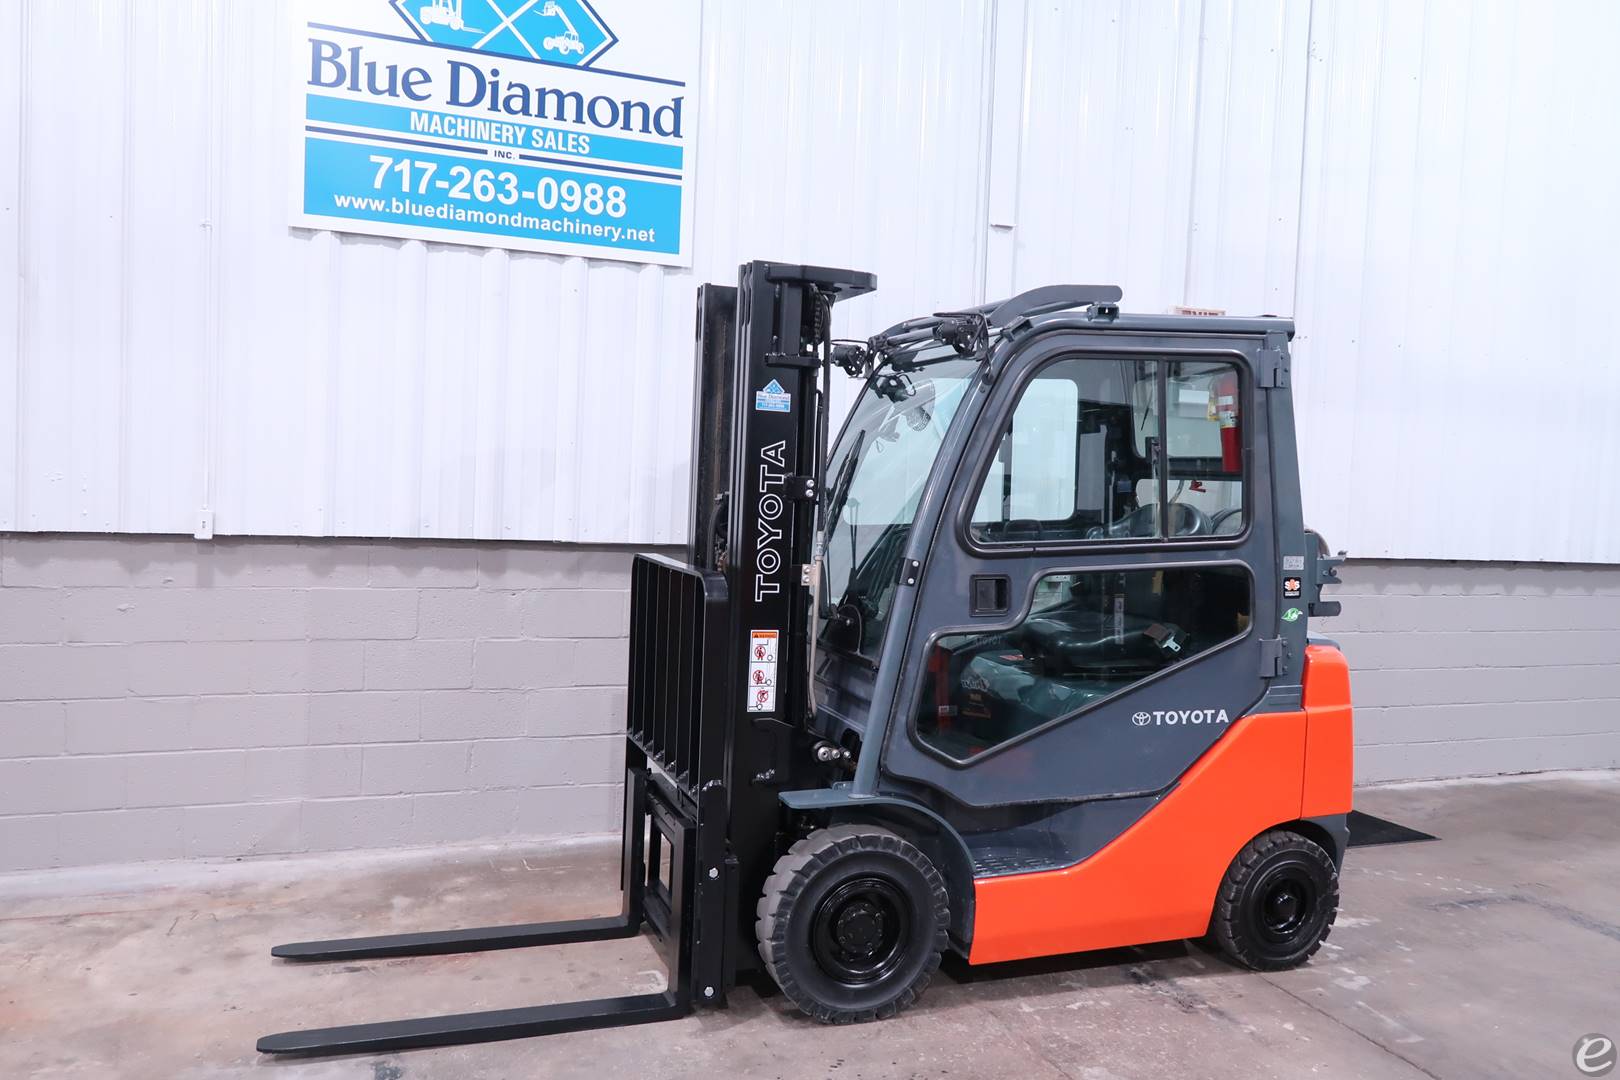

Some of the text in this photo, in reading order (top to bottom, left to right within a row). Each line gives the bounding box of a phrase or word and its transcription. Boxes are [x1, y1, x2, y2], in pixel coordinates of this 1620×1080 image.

[307, 37, 685, 139] Blue Diamond
[410, 111, 590, 155] MACHINERY SALES
[493, 149, 516, 161] INC.
[369, 154, 627, 218] 717-263-0988
[333, 193, 656, 243] www.bluediamondmachinery.net
[754, 439, 786, 603] TOYOTA
[1152, 708, 1230, 726] TOYOTA
